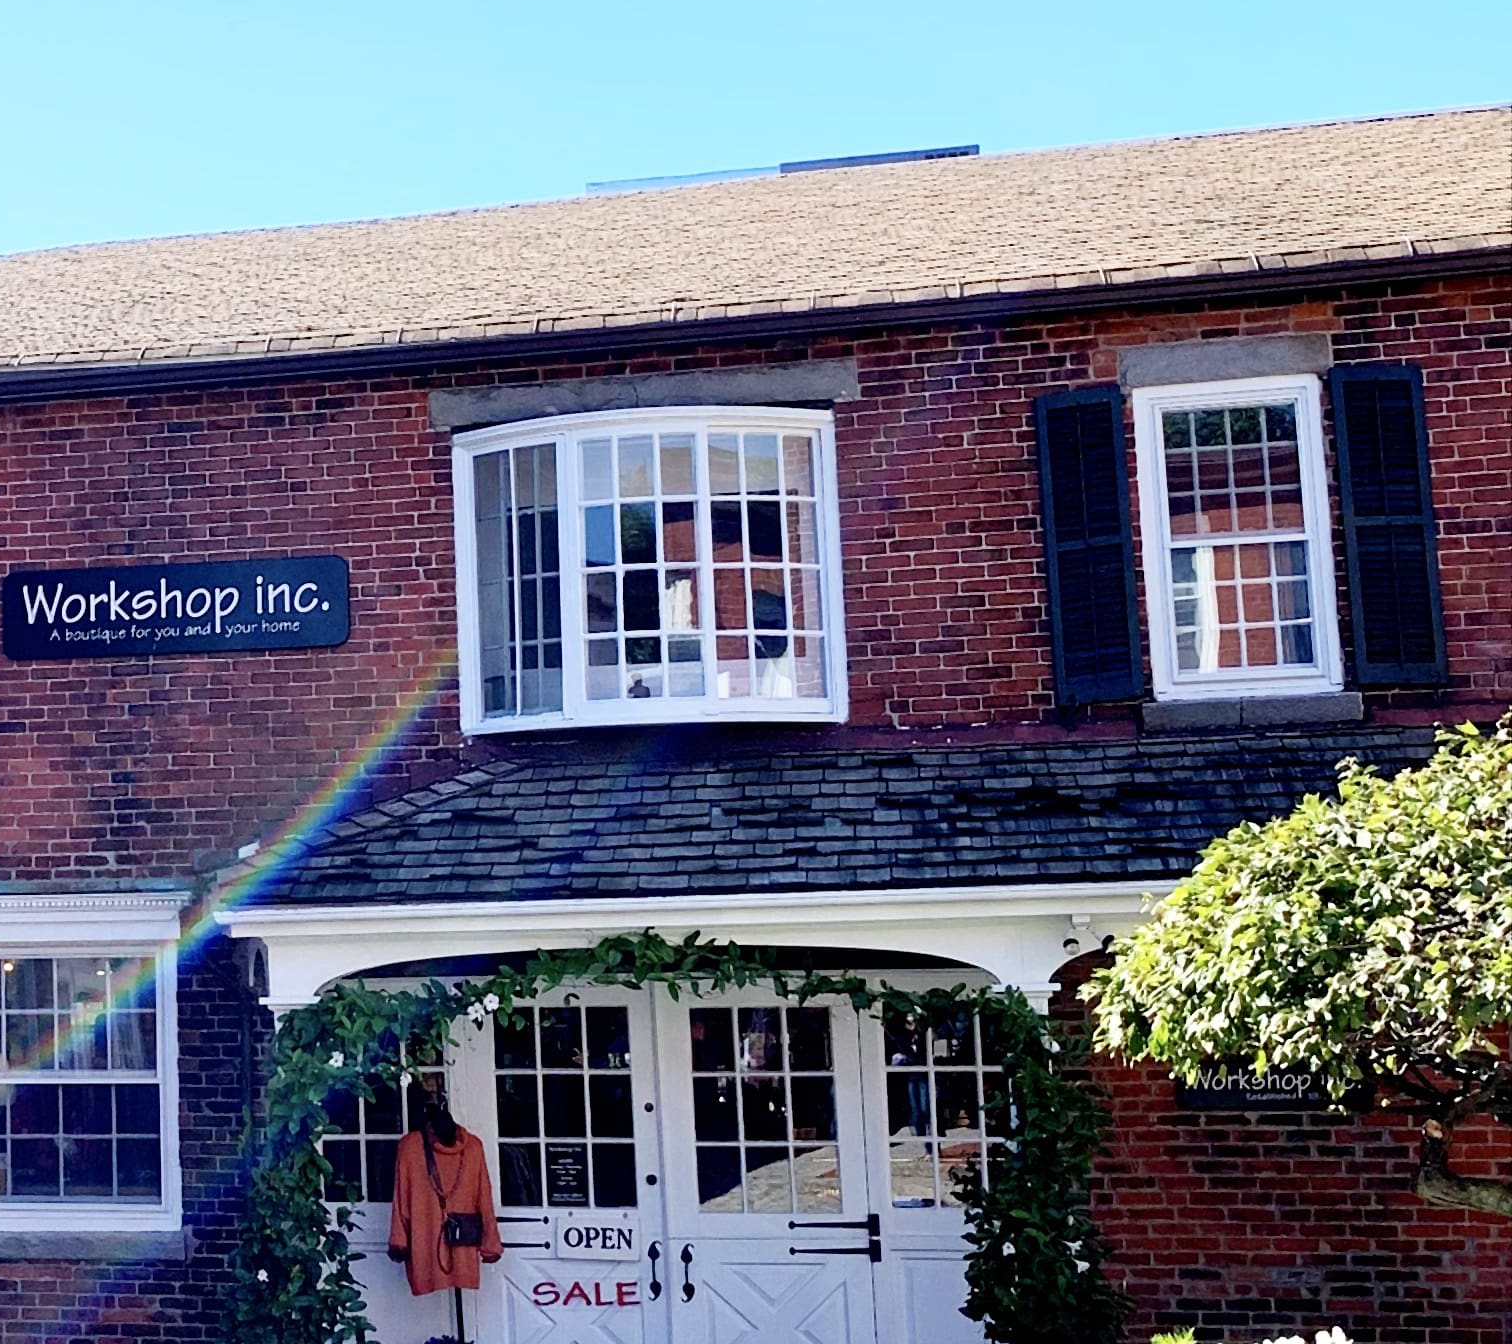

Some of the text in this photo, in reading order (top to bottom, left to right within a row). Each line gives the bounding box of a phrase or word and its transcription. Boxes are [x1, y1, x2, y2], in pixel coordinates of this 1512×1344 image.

[22, 575, 331, 634] Workshop inc.
[49, 619, 301, 644] A boutique for you and your home
[1189, 1067, 1311, 1098] Workshop
[563, 1227, 633, 1250] OPEN
[532, 1281, 641, 1306] SALE
